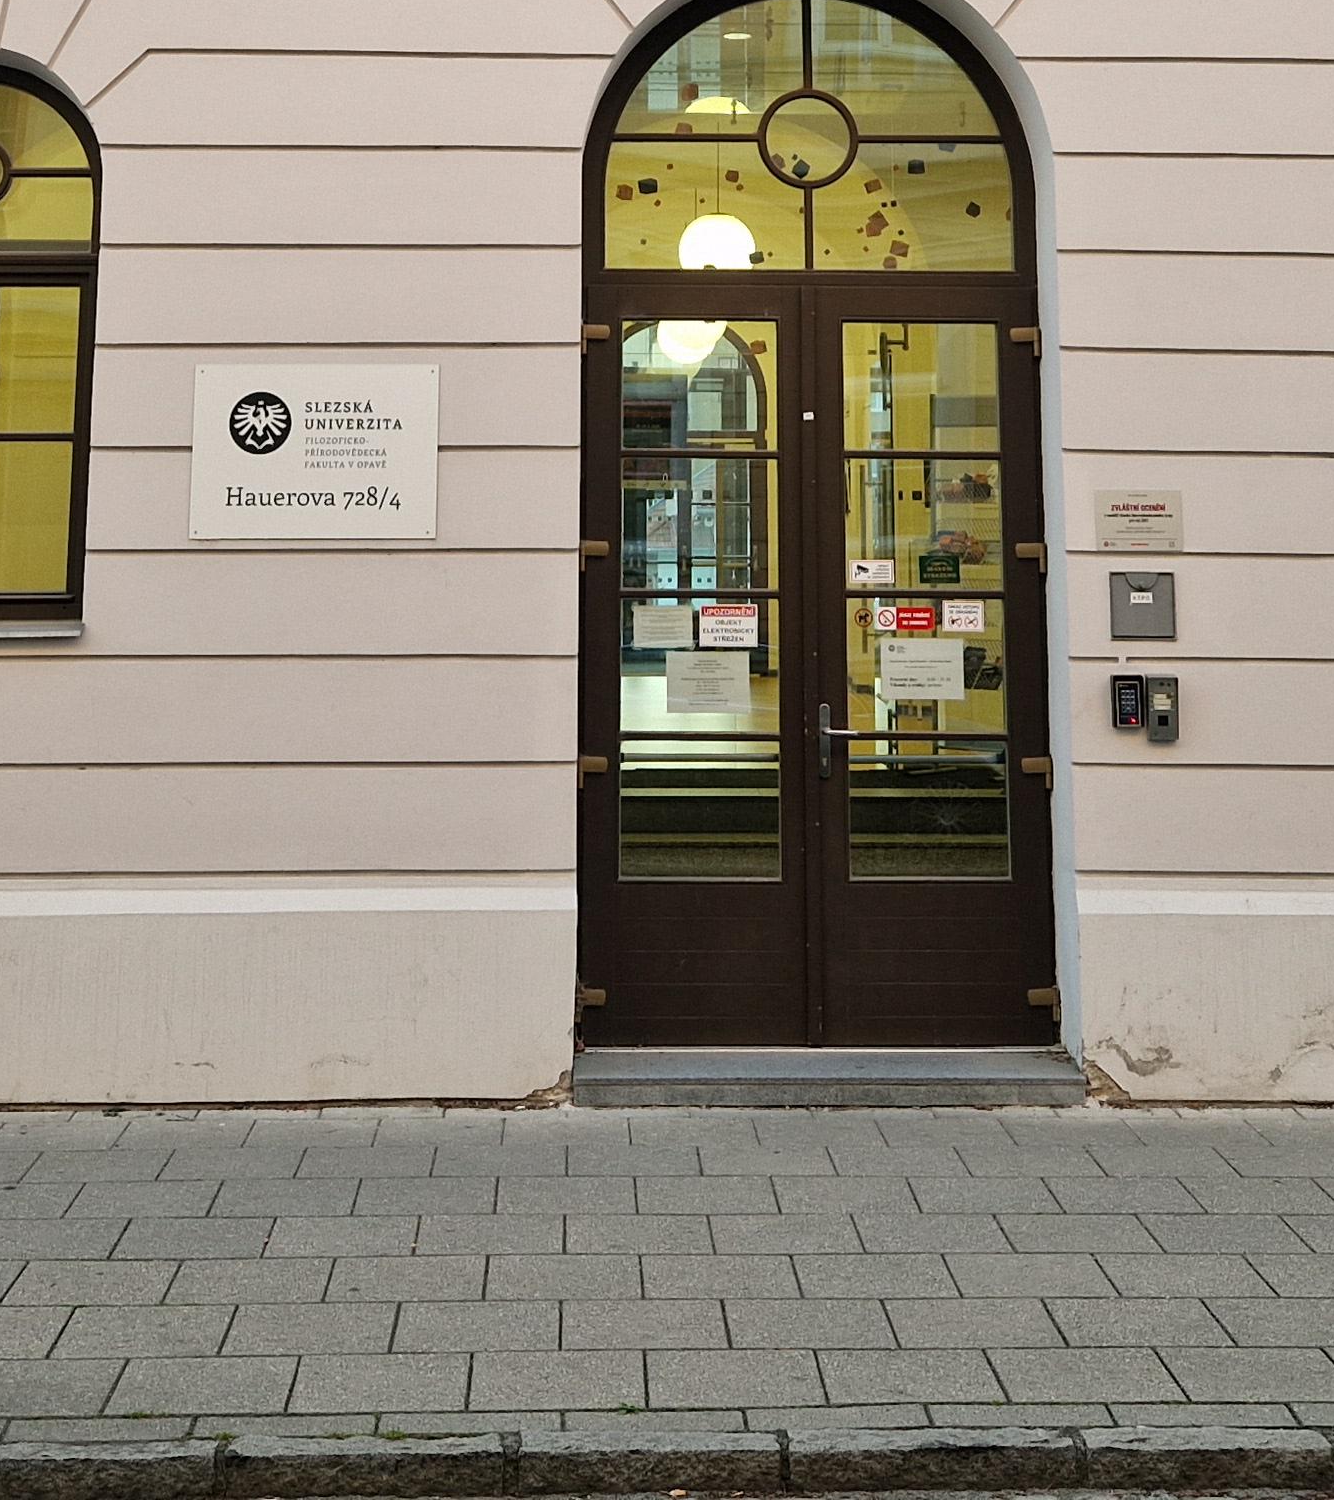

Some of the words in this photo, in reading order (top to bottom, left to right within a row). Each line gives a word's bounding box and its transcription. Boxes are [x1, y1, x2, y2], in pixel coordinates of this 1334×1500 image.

[304, 399, 373, 413] SLEZSKÁ
[304, 418, 403, 430] UNIVERZITA
[305, 436, 369, 445] FILOZOFICKO-
[304, 447, 387, 457] PŘÍRODOVĚDECKÁ
[304, 460, 345, 469] FAKULTA
[348, 460, 355, 469] V
[356, 458, 387, 469] OPAVĚ
[225, 486, 337, 507] Hauerova
[343, 485, 402, 511] 728/4
